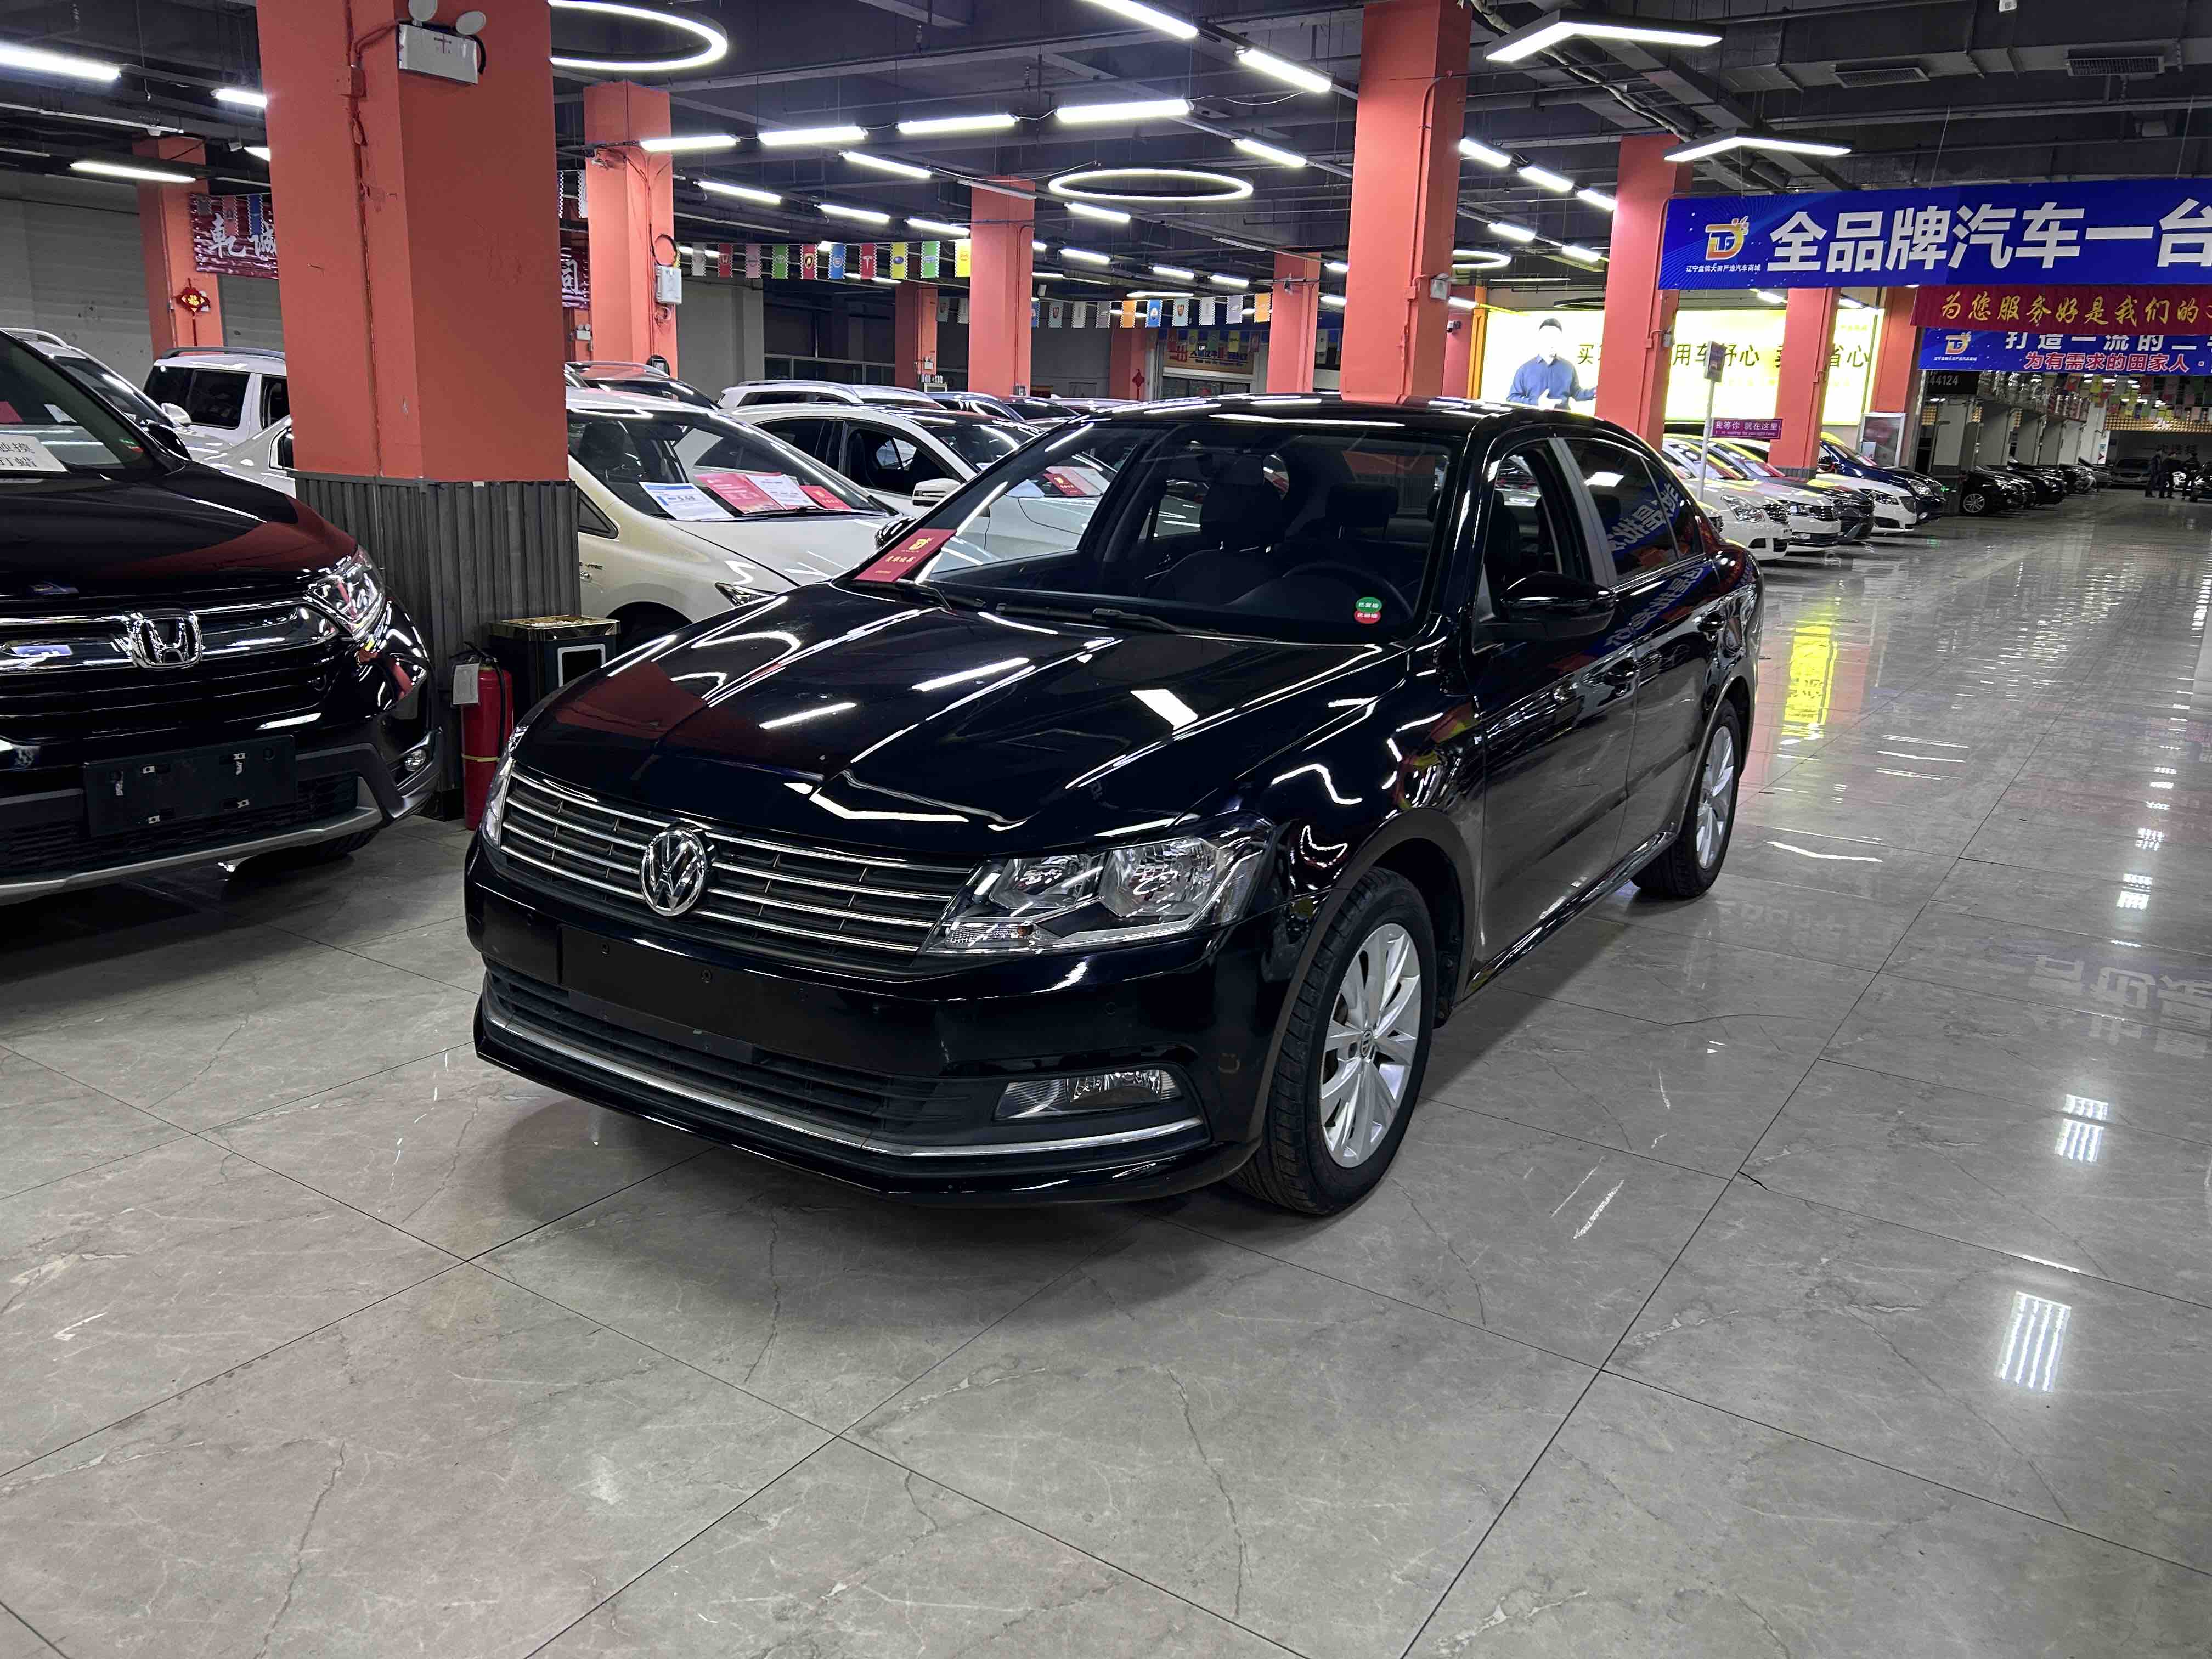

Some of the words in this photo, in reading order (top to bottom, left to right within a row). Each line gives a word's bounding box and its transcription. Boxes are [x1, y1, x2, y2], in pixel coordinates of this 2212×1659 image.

[1767, 198, 2212, 272] 全品牌汽车一台
[1942, 290, 2212, 327] 为您服务好是我们的
[2005, 331, 2212, 351] 打造一流的
[1926, 375, 1959, 386] 44124
[1715, 421, 1740, 430] 我等你
[1744, 422, 1778, 431] 就在这里
